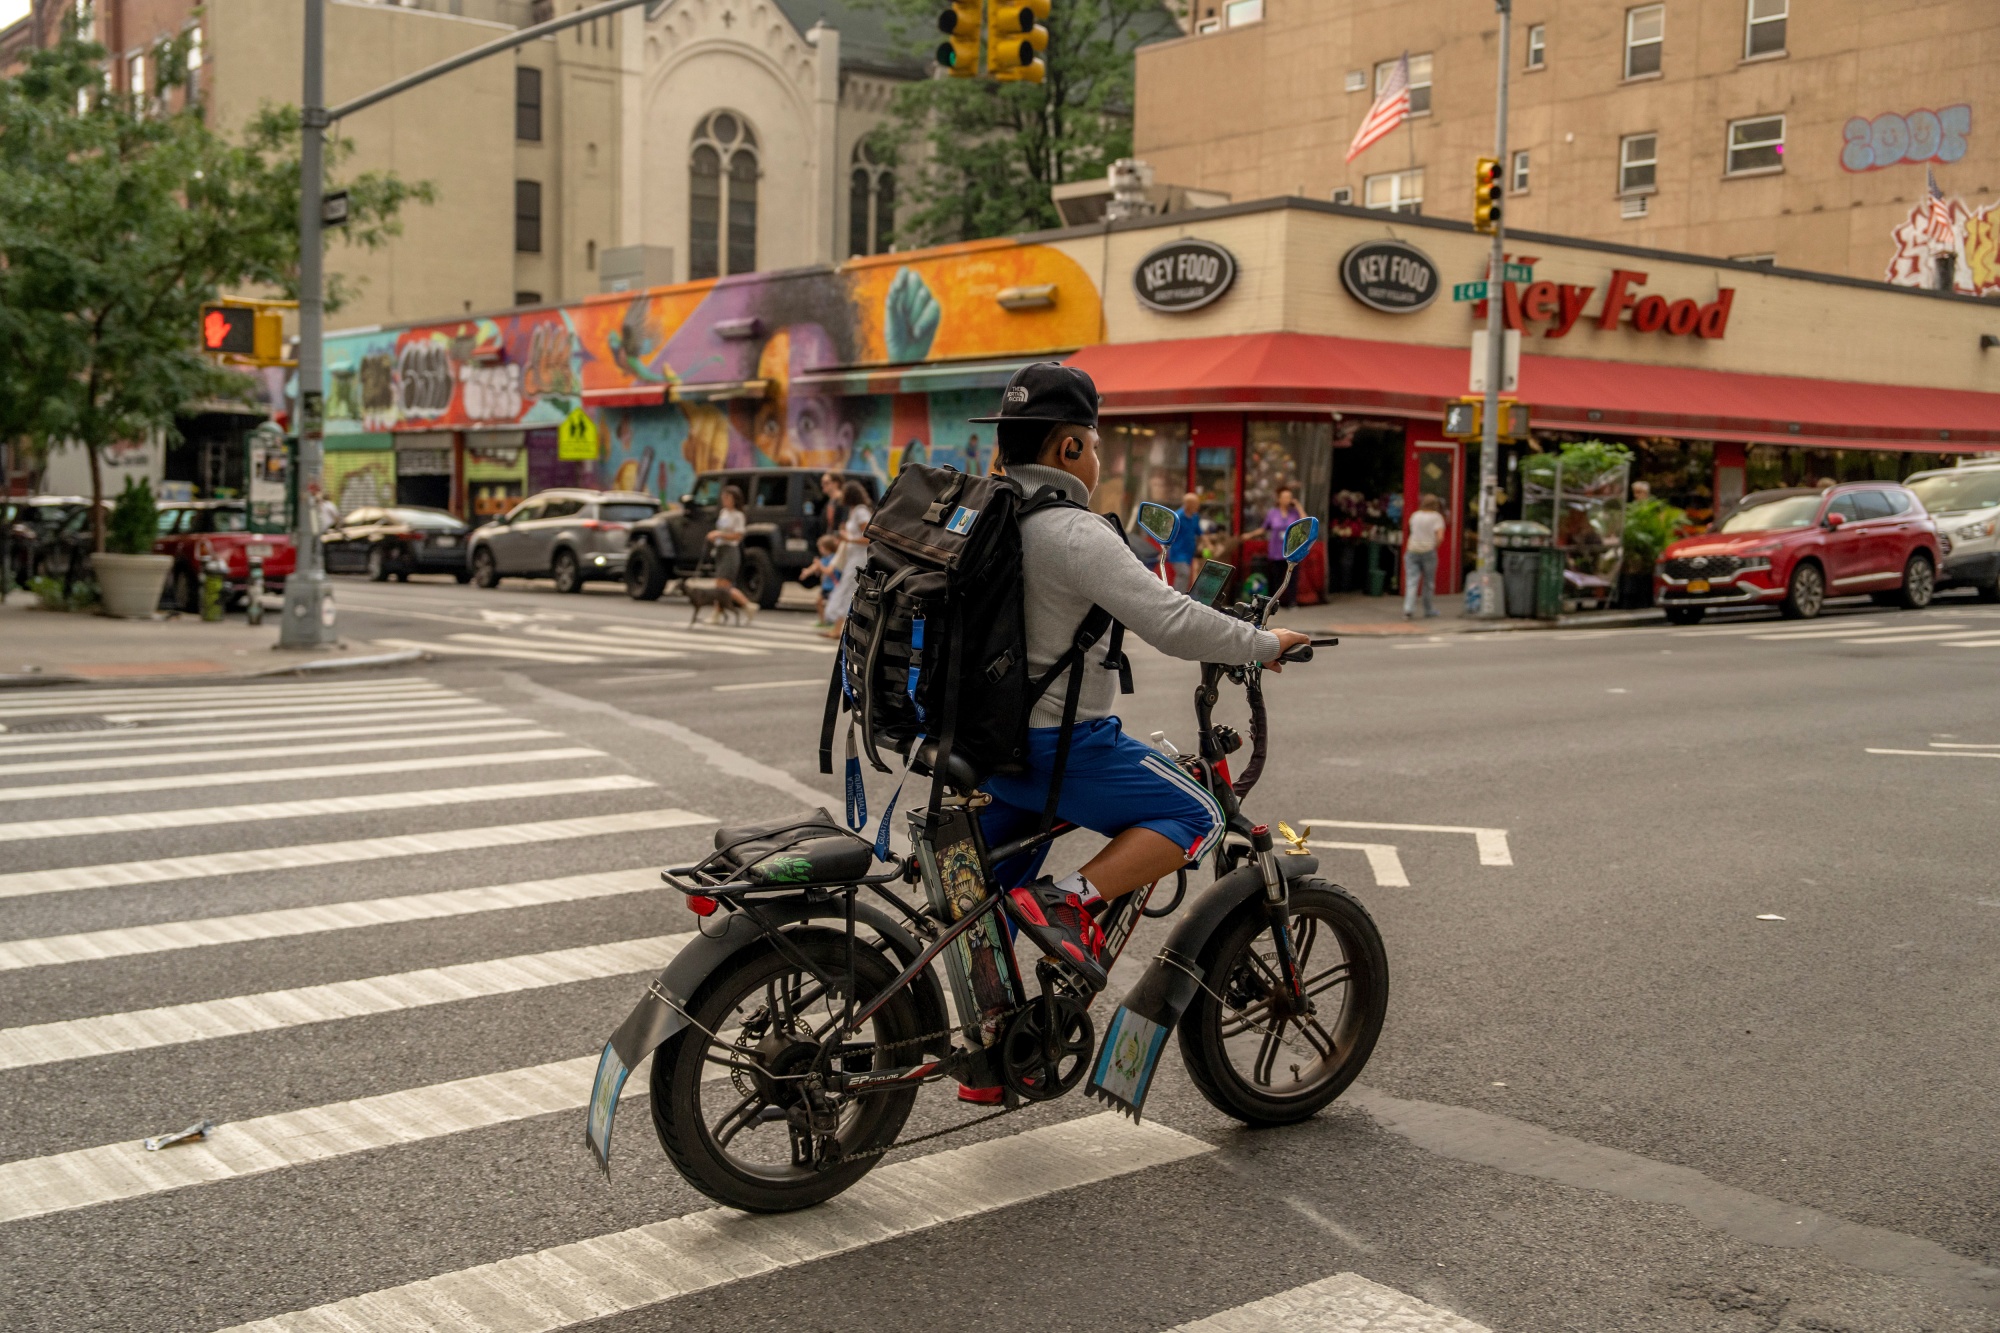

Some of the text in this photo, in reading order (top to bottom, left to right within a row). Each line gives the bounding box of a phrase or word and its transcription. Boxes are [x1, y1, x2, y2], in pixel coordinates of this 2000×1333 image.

[1144, 254, 1220, 291] KEY FOOD
[1358, 254, 1430, 293] KEY FOOD
[1597, 269, 1736, 340] Food
[854, 773, 866, 818] GUATEMALA
[877, 801, 895, 845] GUATEMALA
[1105, 904, 1133, 958] EP
[848, 1075, 869, 1086] EP
